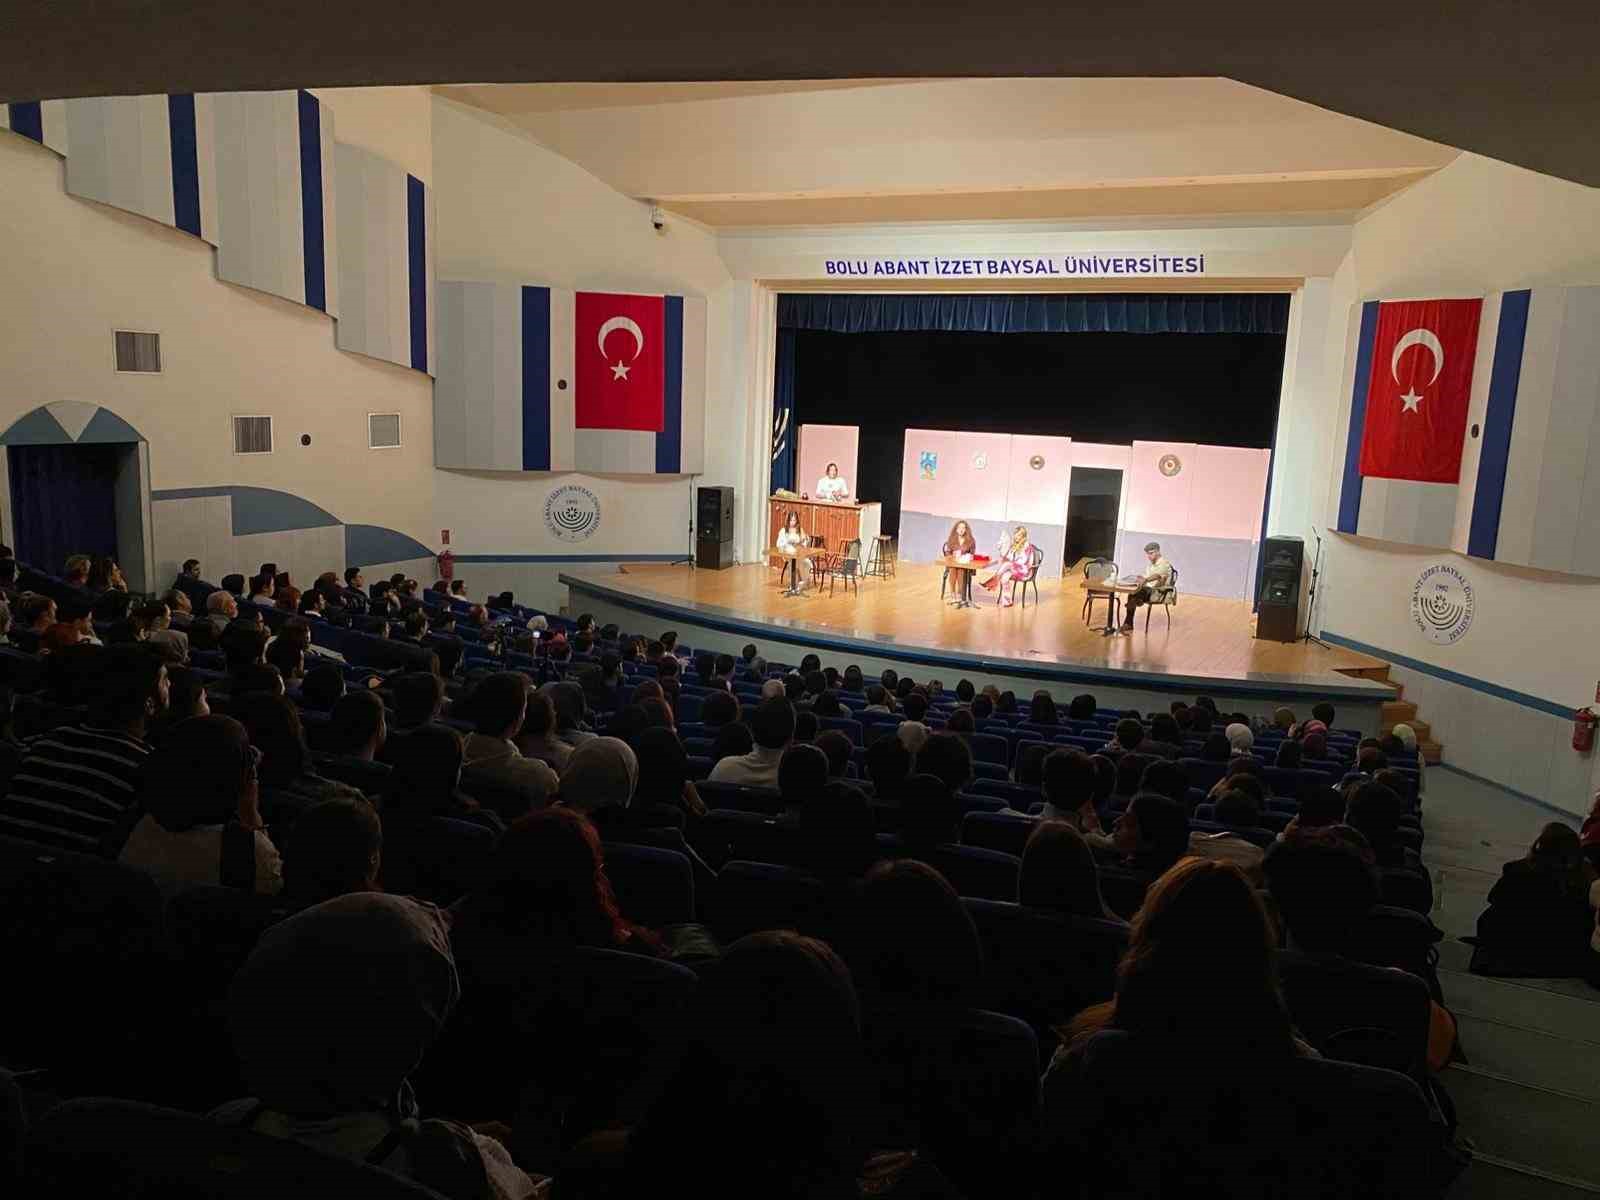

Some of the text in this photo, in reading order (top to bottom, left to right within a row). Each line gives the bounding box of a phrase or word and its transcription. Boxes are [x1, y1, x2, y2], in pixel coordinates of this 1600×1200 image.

[825, 254, 1205, 275] BOLU ABANT İZZET BAYSAL ÜNİVERSİTESİ
